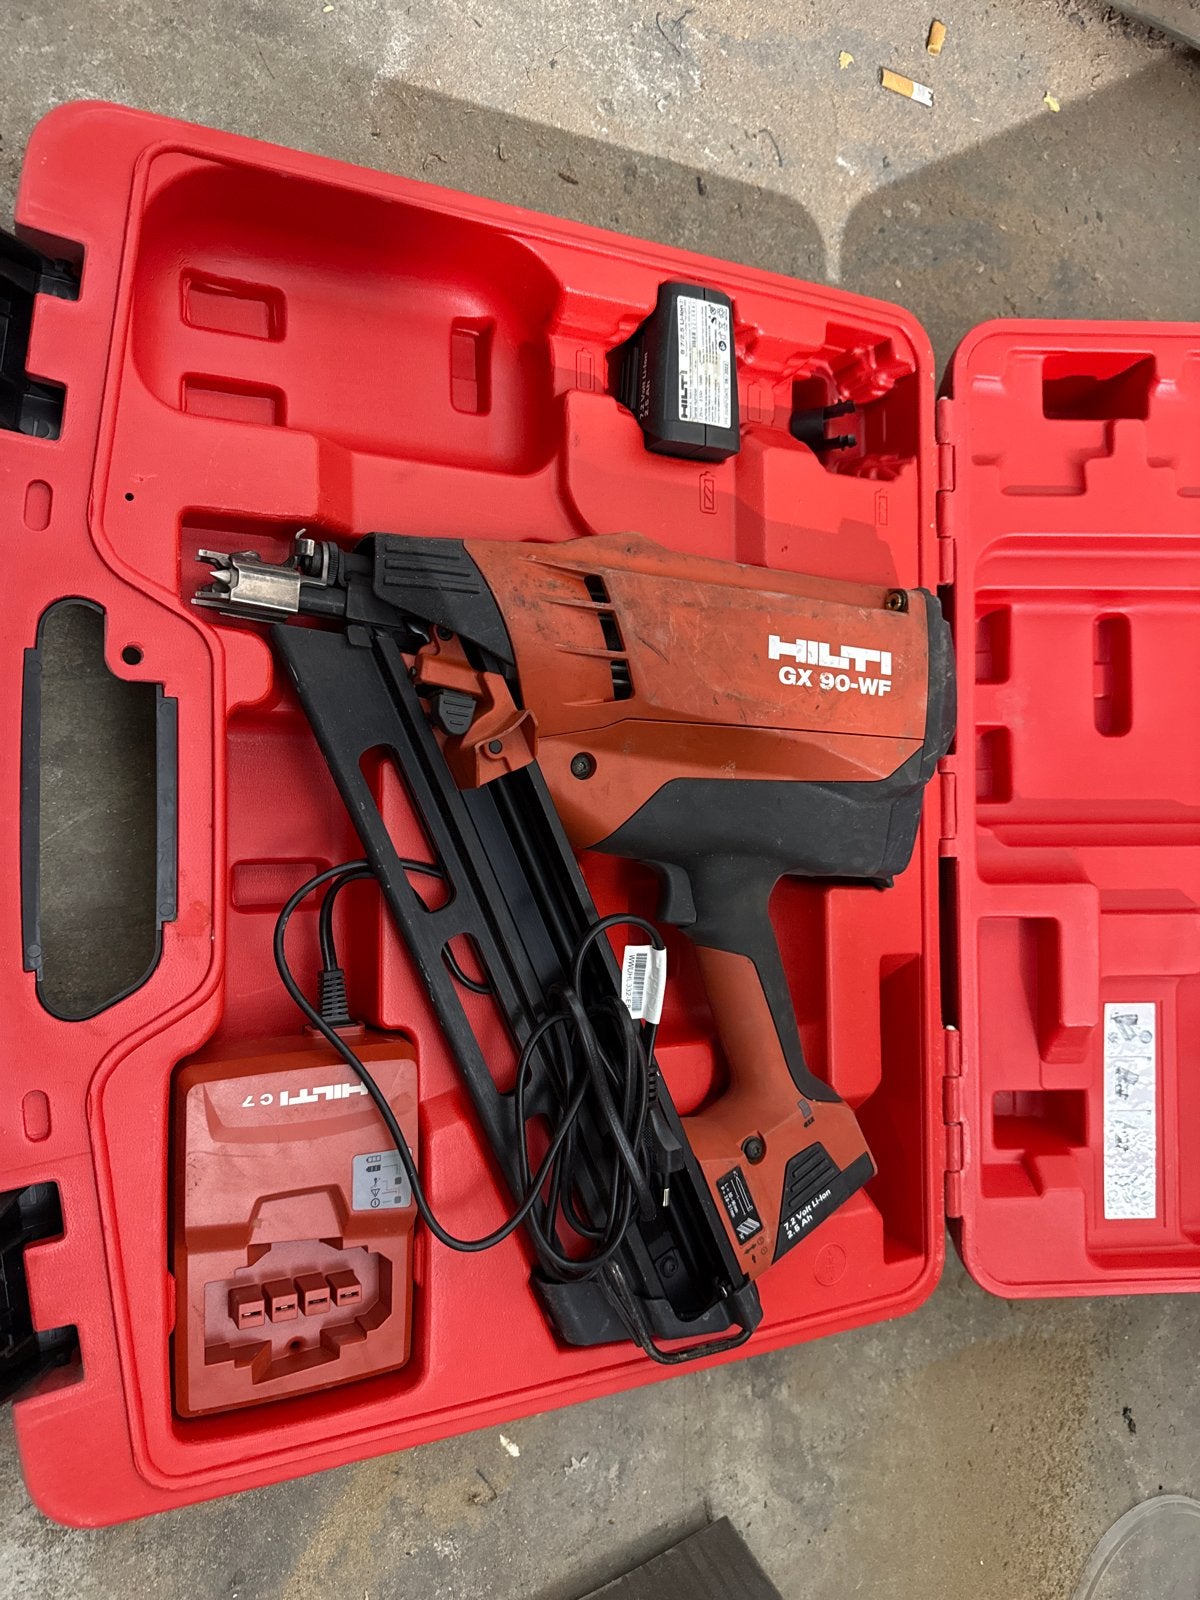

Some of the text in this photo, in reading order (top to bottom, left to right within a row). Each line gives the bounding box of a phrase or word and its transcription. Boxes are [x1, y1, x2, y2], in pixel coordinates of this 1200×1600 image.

[645, 379, 651, 396] Ah
[680, 370, 688, 419] HILTI
[768, 634, 892, 676] HILTI
[778, 666, 892, 697] GX 90-WF
[241, 1081, 368, 1108] HILTI C 7
[783, 1189, 832, 1231] 7.2 Volt Li-Ion
[801, 1214, 814, 1228] Ah
